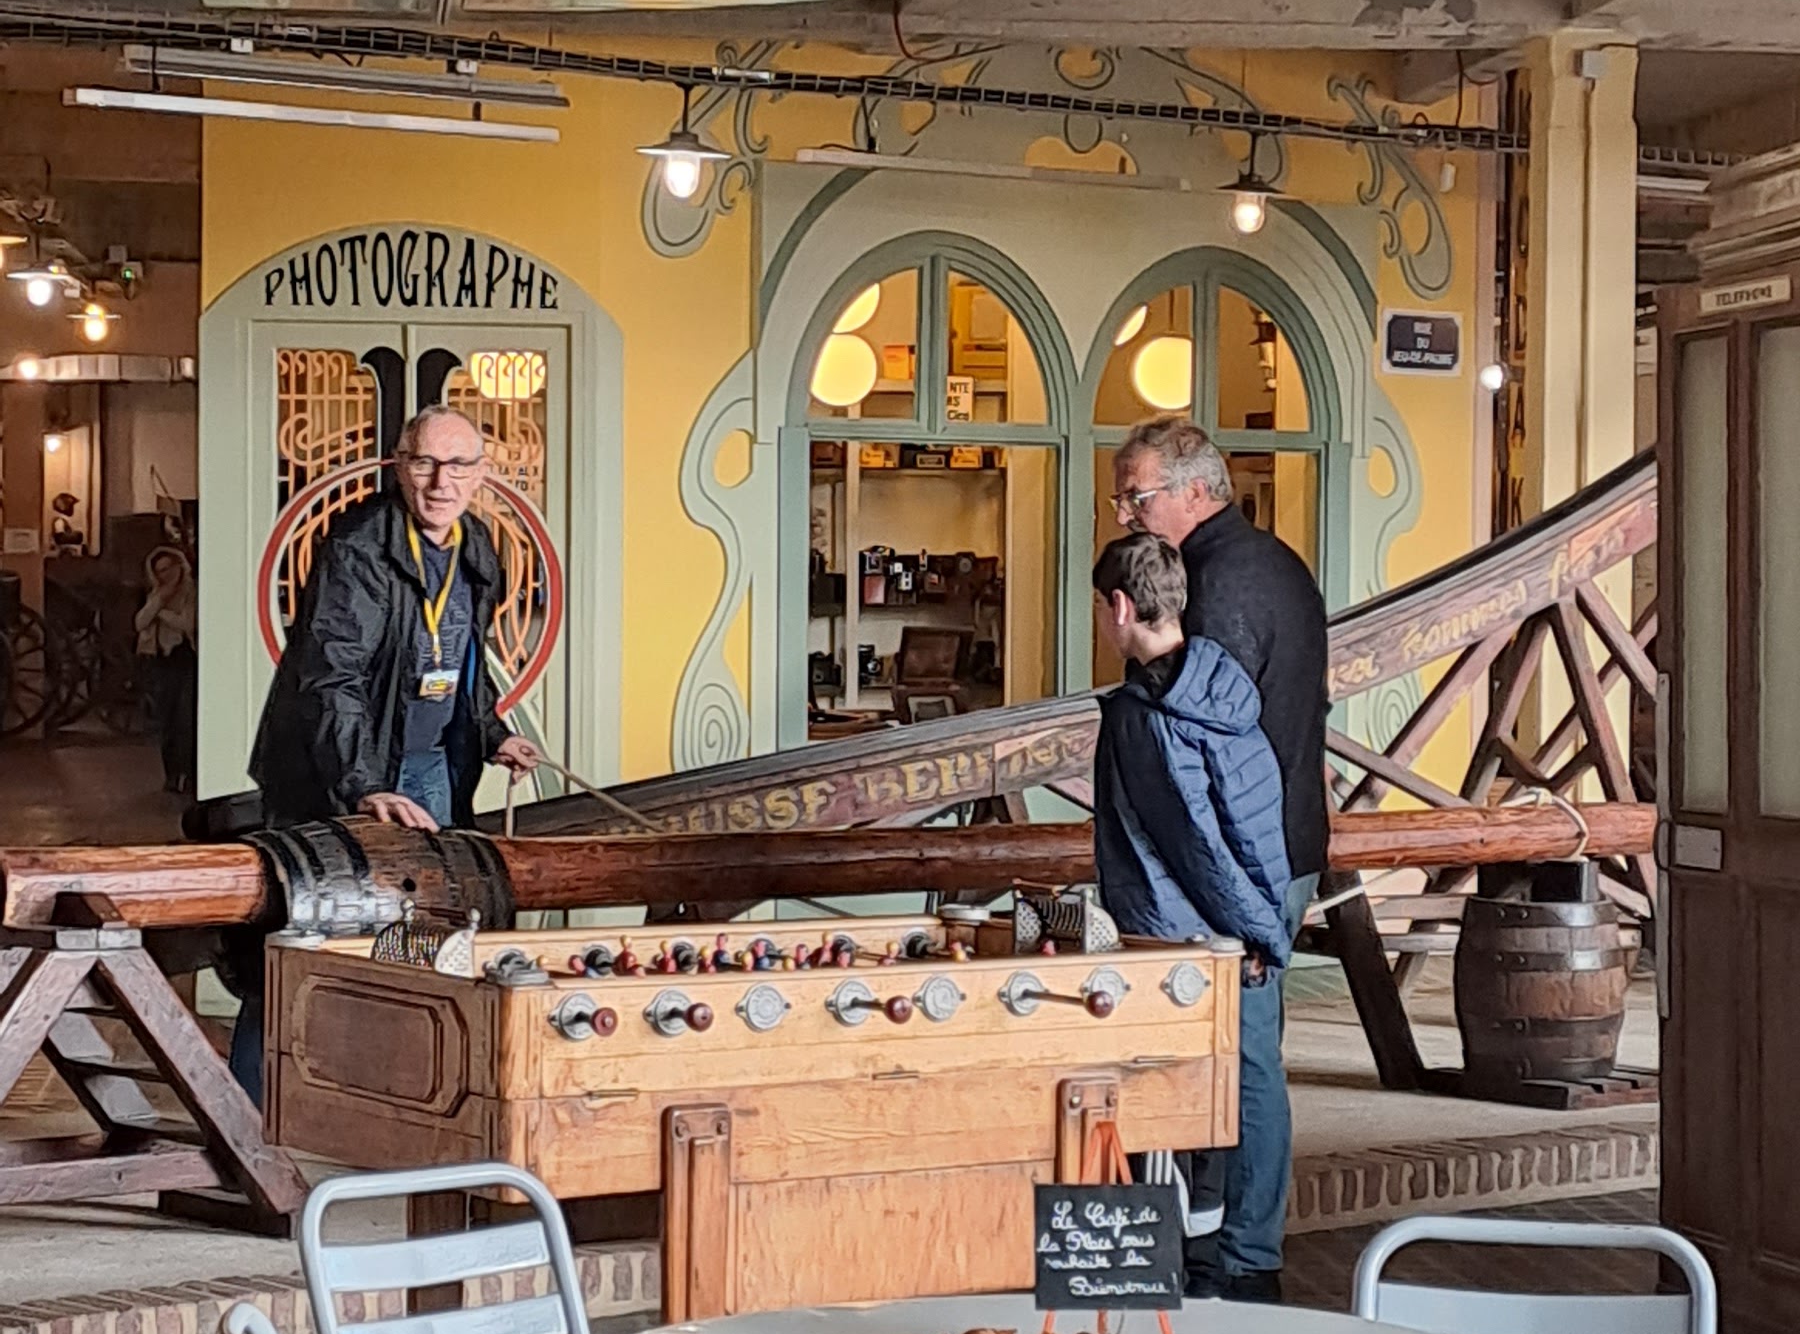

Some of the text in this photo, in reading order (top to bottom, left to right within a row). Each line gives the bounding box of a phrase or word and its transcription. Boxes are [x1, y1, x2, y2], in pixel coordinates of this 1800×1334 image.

[264, 229, 559, 309] PHOTOGRAPHE
[1051, 1200, 1162, 1239] Le Café de
[1036, 1232, 1060, 1253] la
[1065, 1231, 1114, 1252] Place
[1120, 1248, 1153, 1267] la
